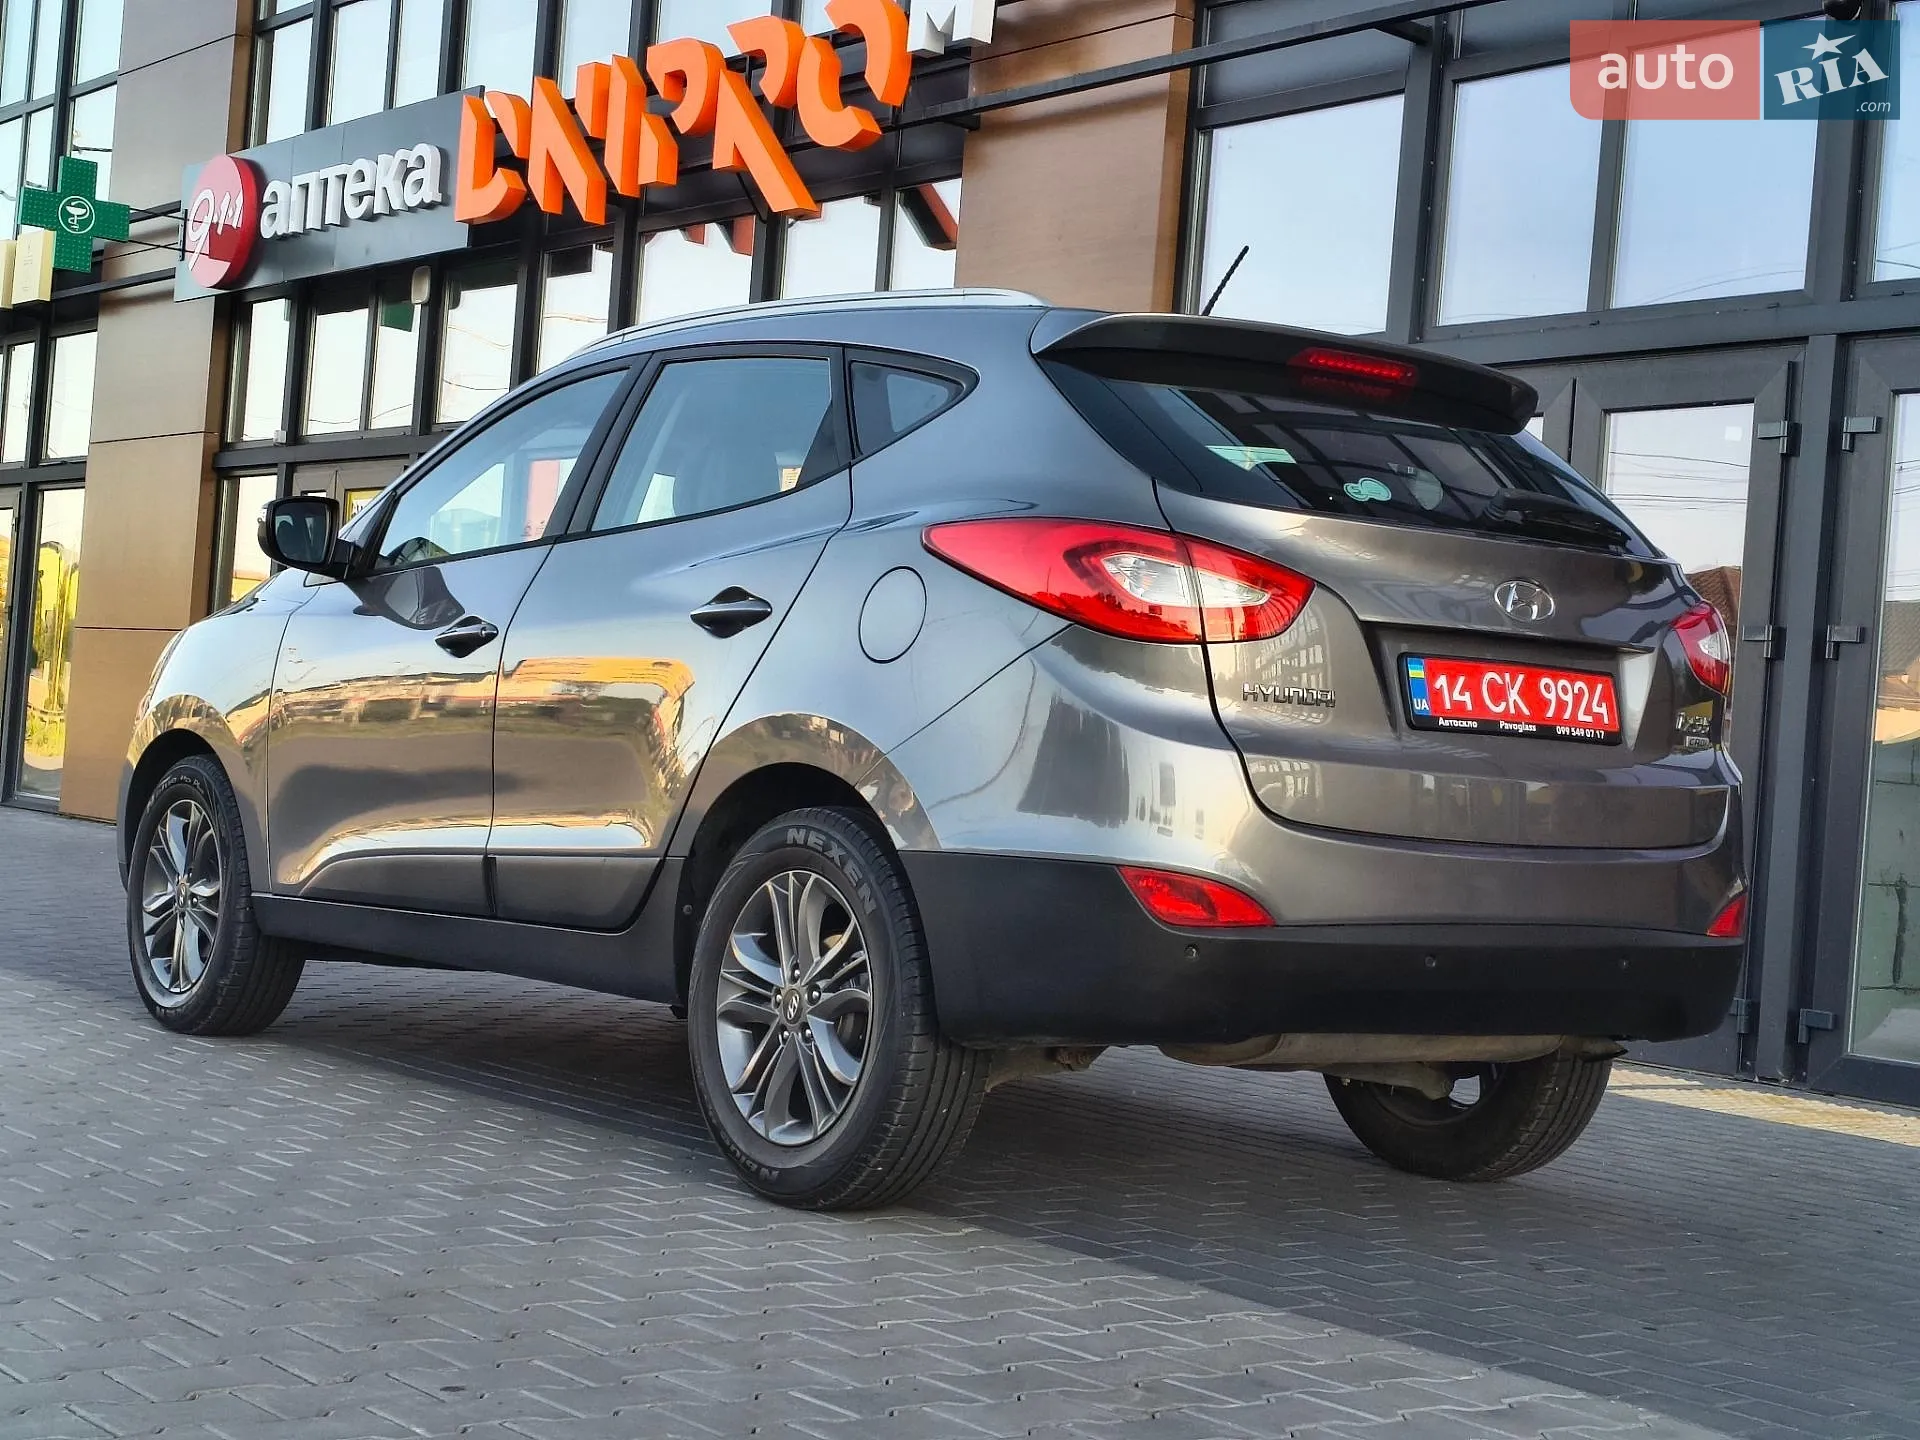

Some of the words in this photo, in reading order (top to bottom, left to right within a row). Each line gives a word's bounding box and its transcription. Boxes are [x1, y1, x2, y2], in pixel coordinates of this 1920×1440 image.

[260, 143, 443, 239] аптека
[1242, 682, 1336, 708] HYUNDAI
[1414, 698, 1430, 711] UA
[1434, 674, 1473, 711] 14
[1481, 671, 1531, 717] CK
[1539, 676, 1609, 725] 9924
[1499, 720, 1537, 733] Pavoglass
[786, 827, 877, 914] NEXEN
